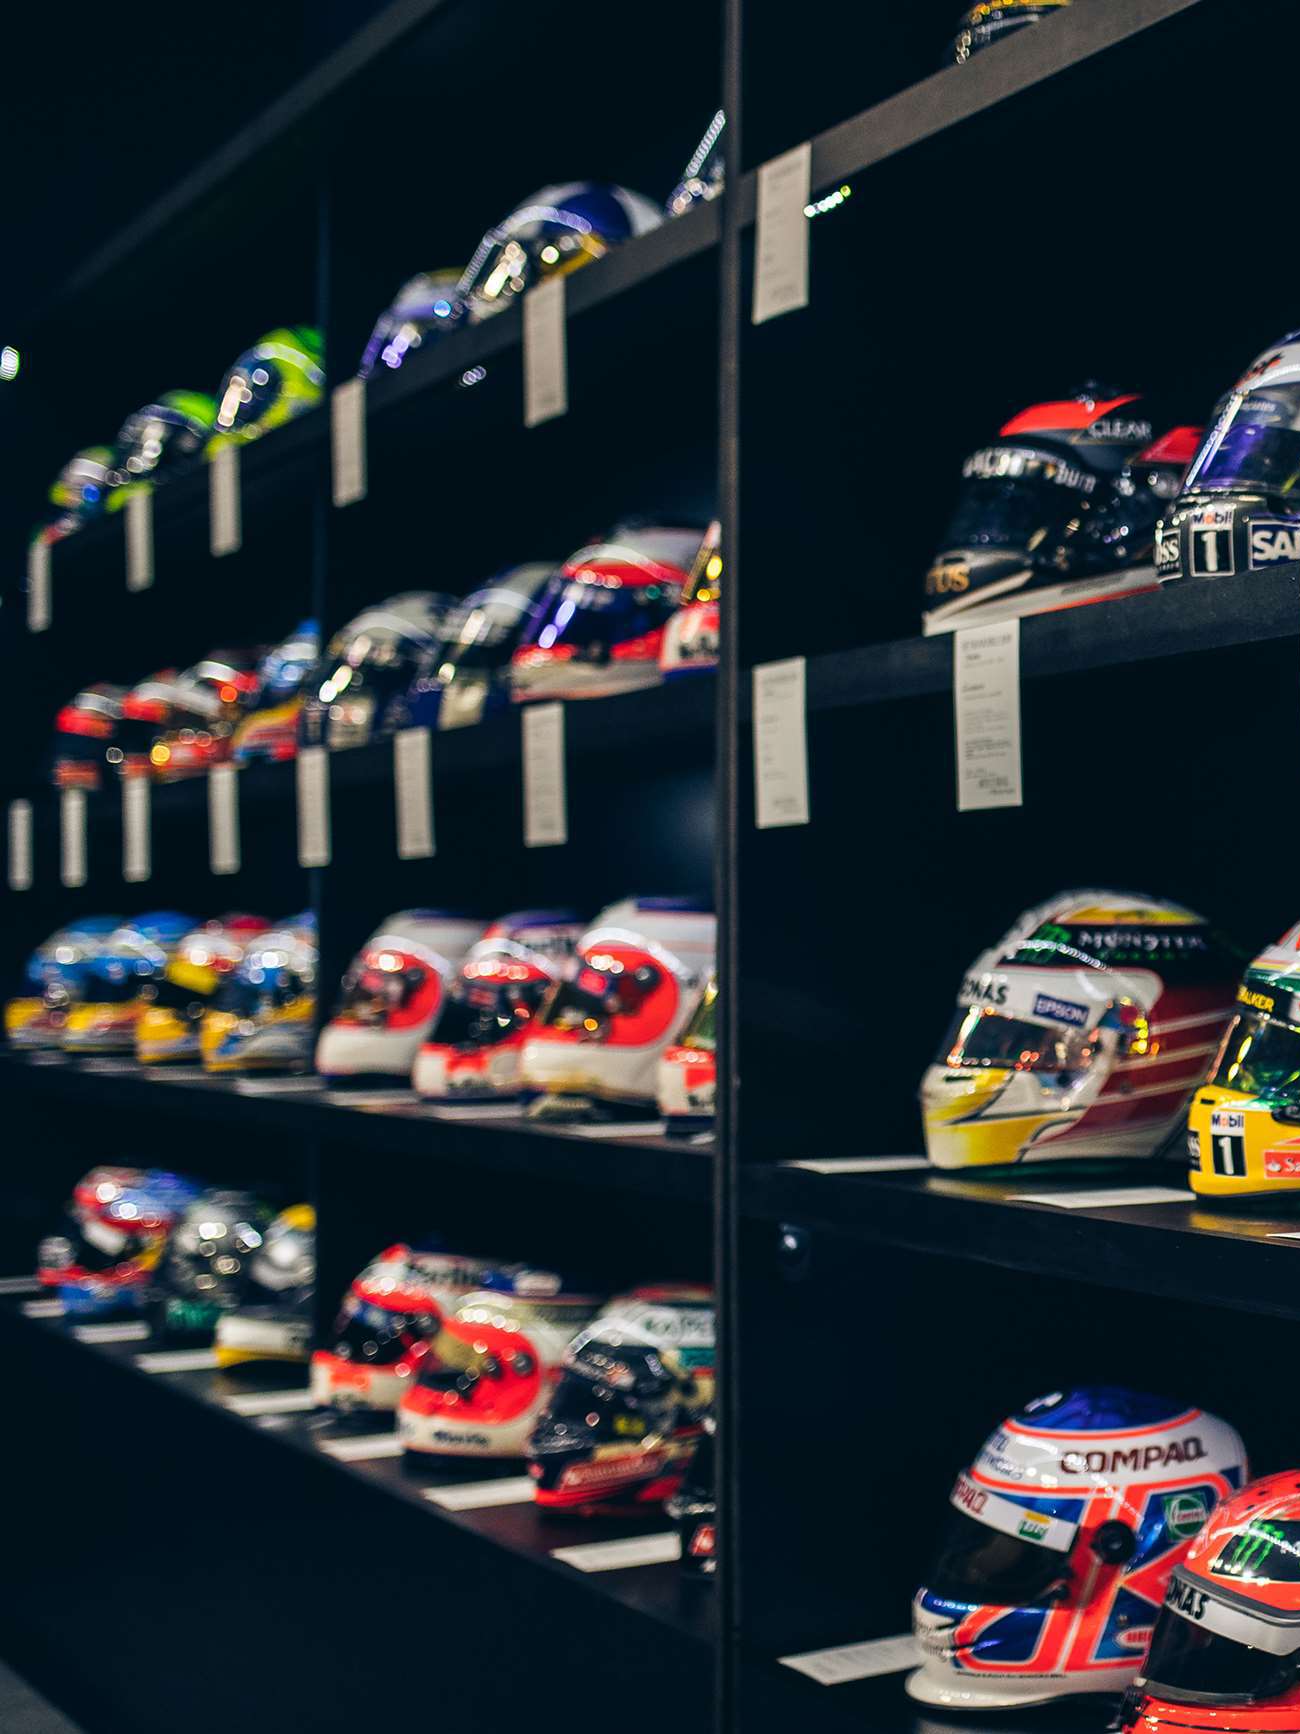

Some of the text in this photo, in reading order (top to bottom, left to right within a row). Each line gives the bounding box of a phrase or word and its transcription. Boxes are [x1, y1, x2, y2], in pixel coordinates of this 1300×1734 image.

[1201, 531, 1218, 572] 1
[1211, 1113, 1244, 1129] Mobil
[1218, 1136, 1235, 1175] 1
[1060, 1437, 1208, 1474] COMPAQ
